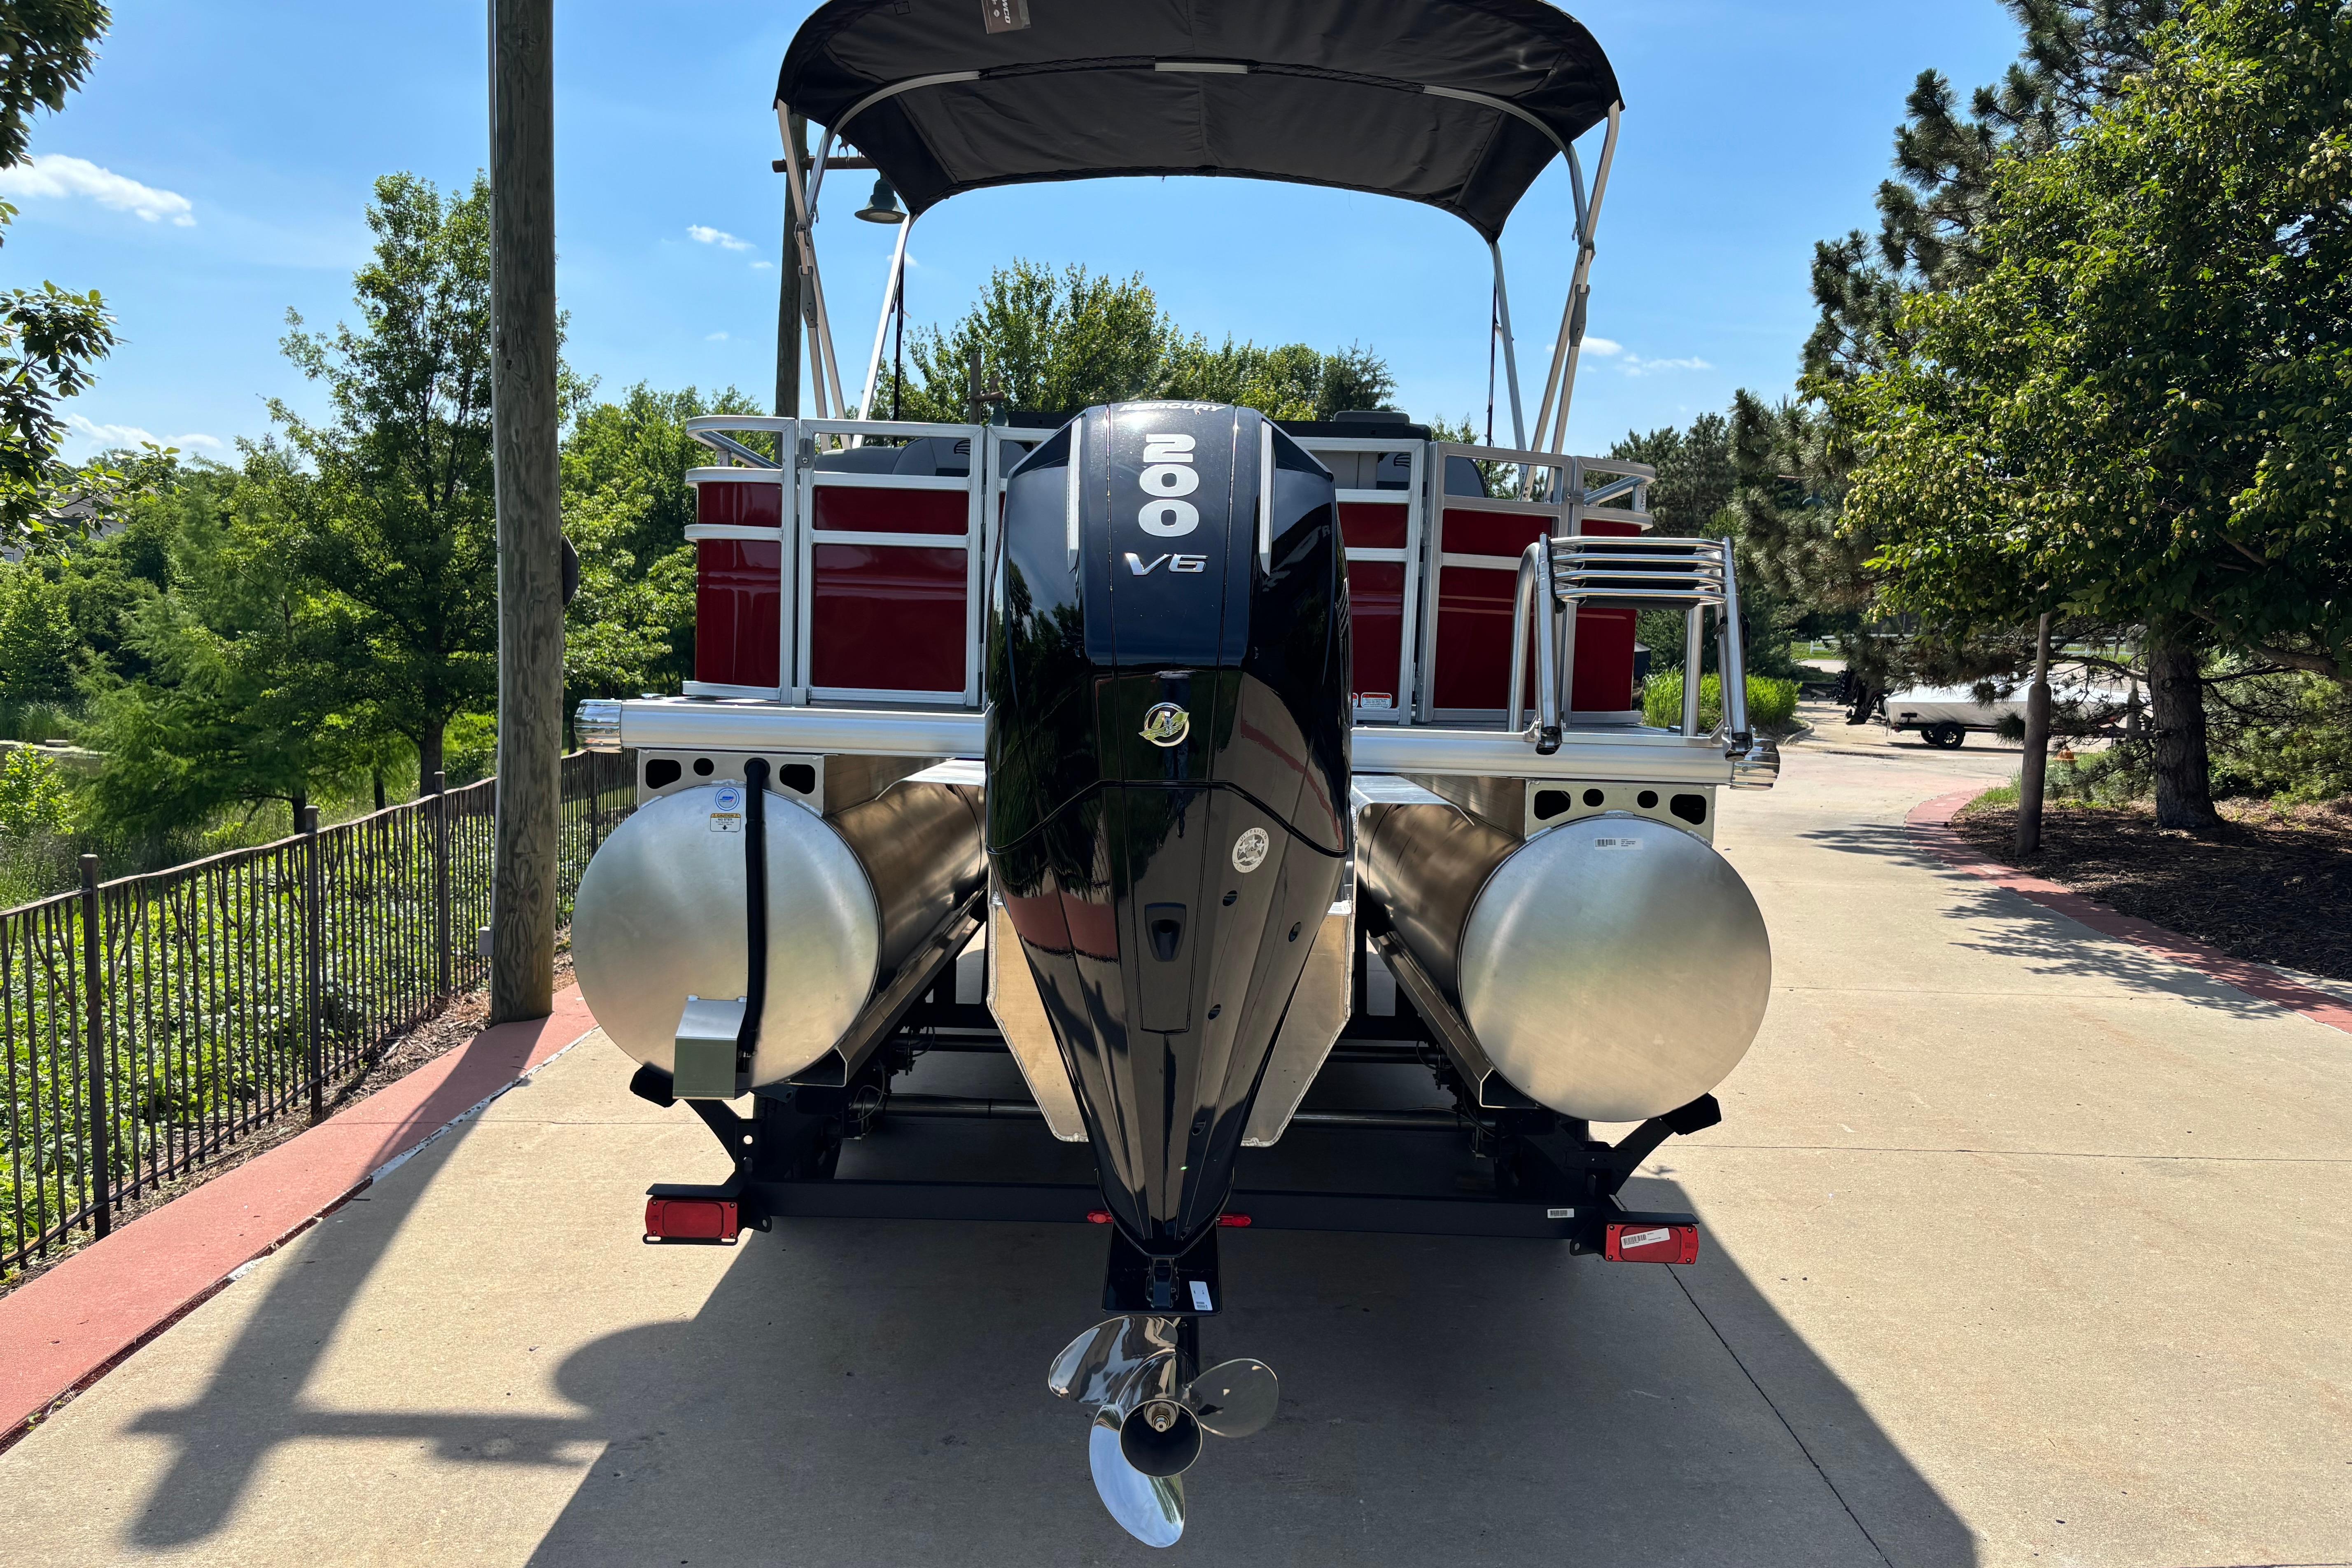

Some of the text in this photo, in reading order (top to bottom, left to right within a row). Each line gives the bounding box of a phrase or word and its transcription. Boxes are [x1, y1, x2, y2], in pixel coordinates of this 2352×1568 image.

[1118, 402, 1226, 412] MERCURY
[1138, 434, 1199, 537] 200
[1125, 552, 1208, 575] V6
